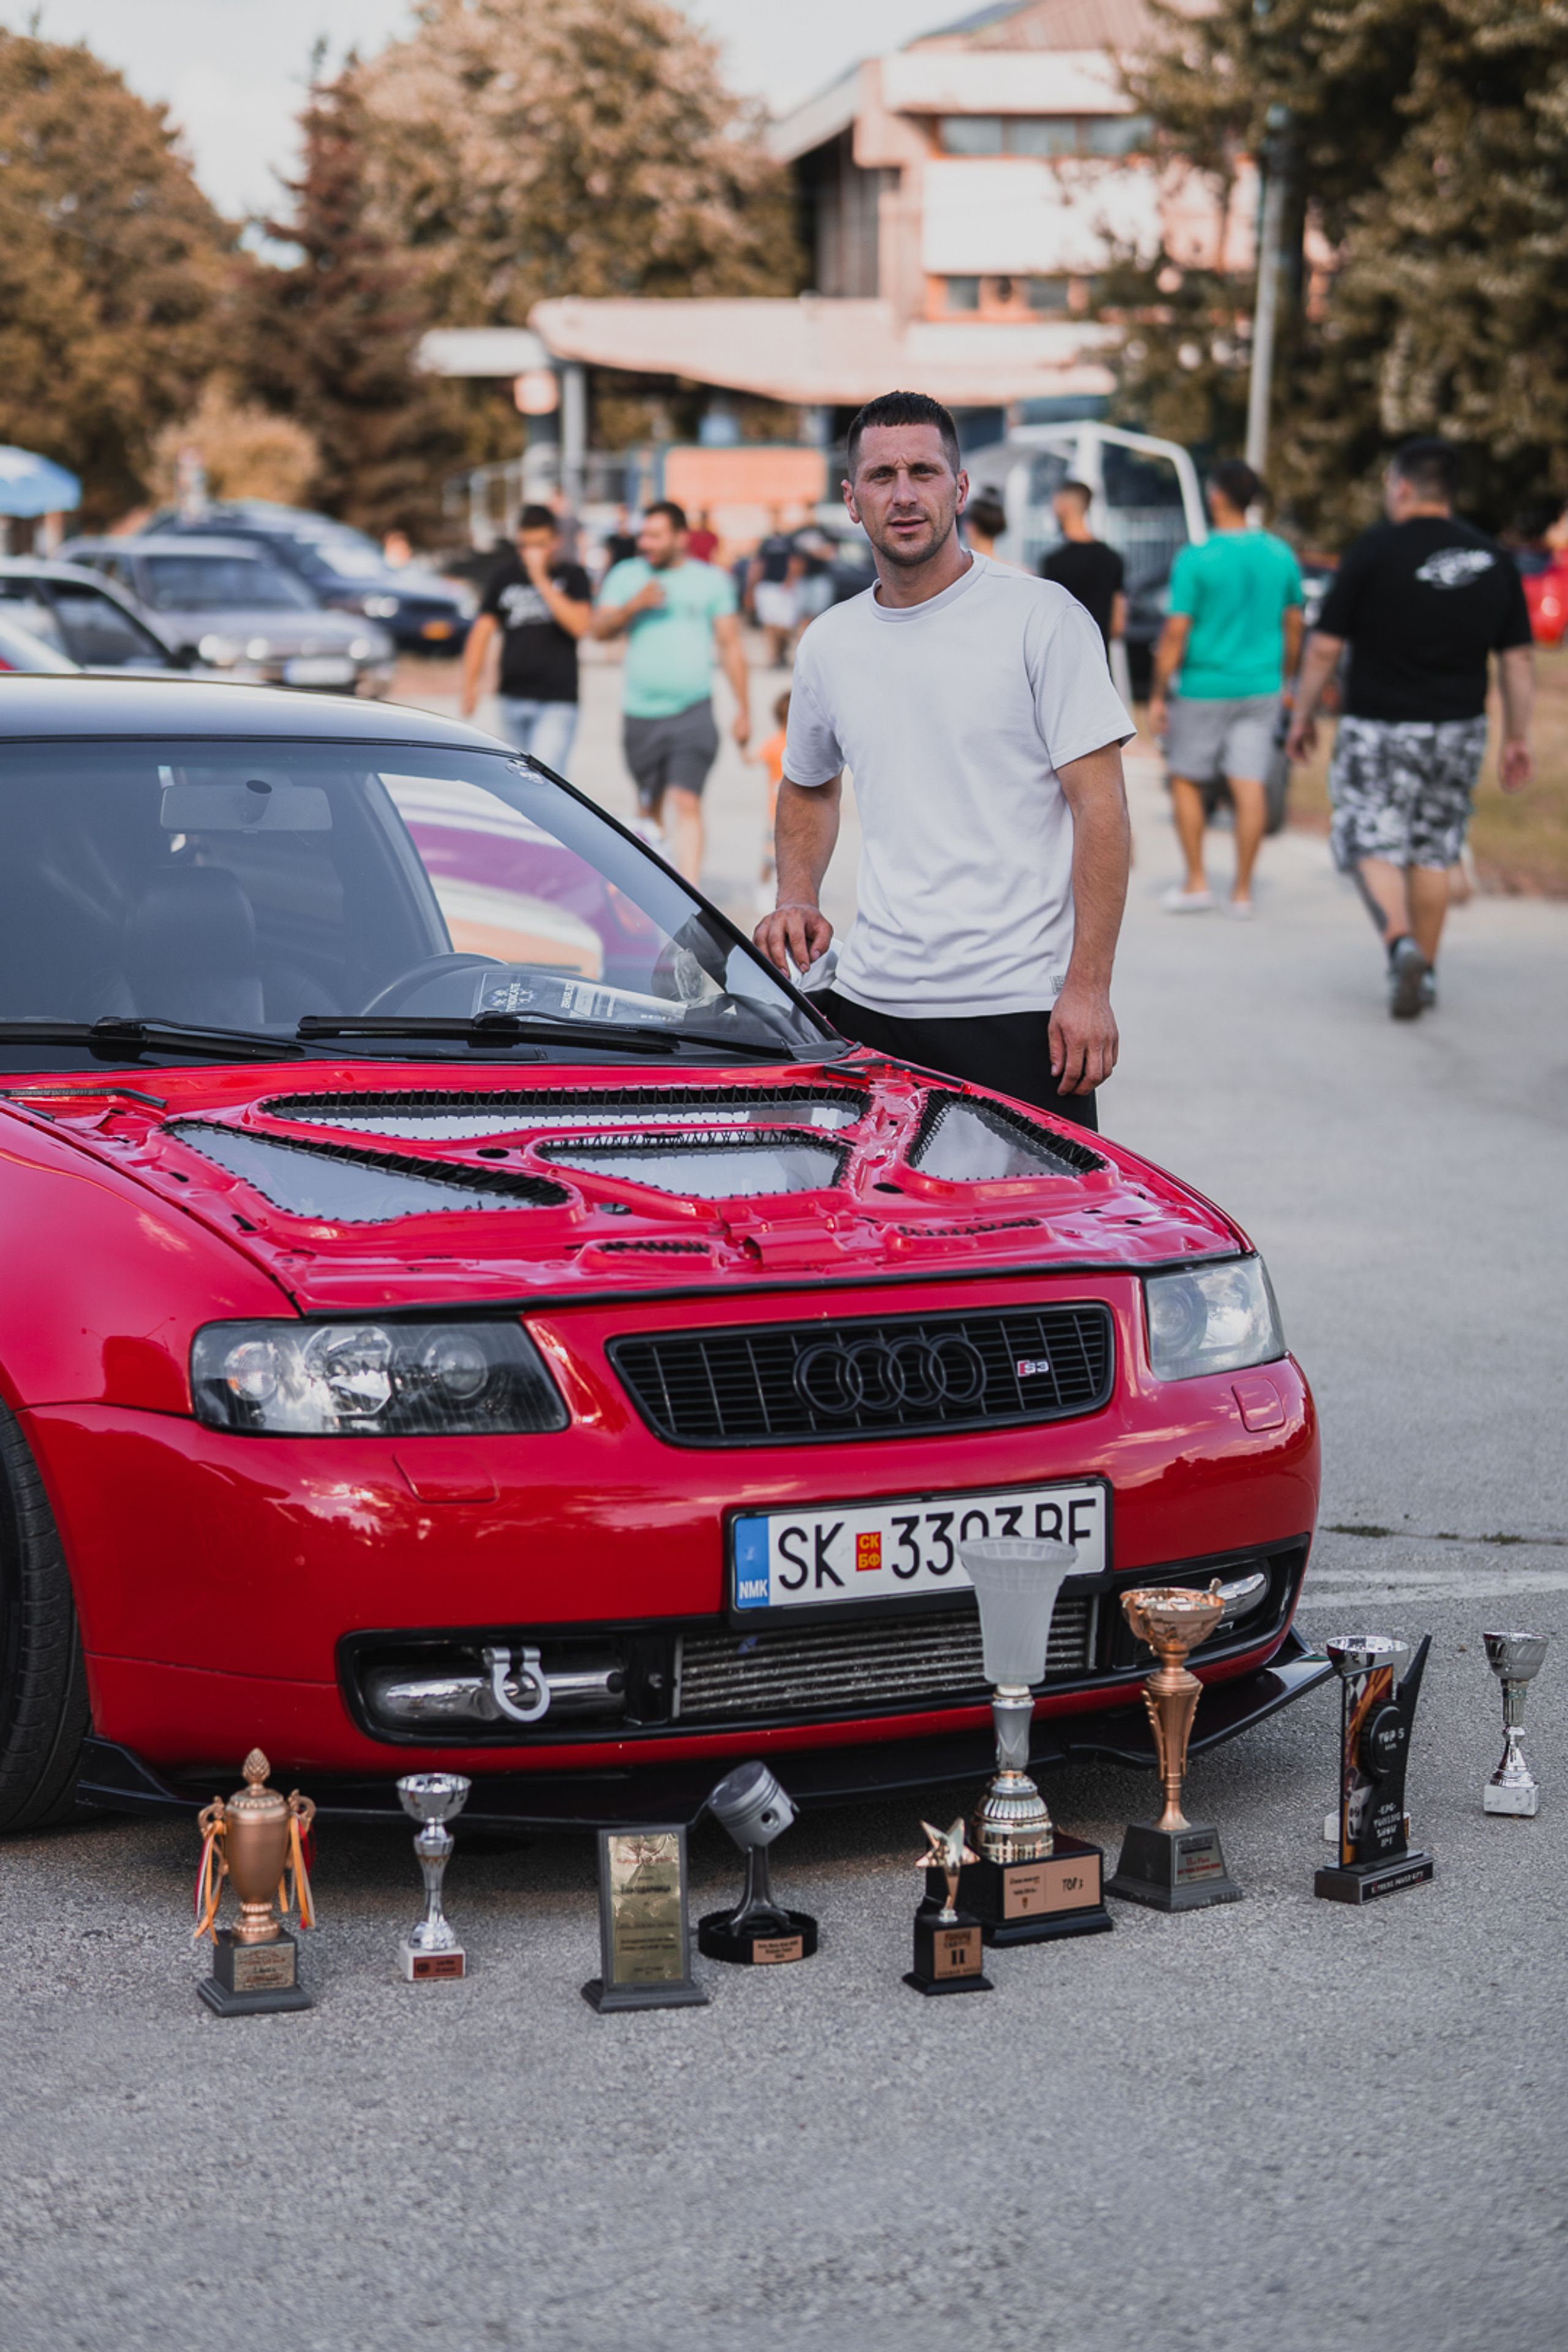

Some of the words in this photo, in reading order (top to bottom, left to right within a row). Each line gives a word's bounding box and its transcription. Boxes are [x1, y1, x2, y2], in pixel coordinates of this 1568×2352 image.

[1024, 1361, 1049, 1374] S3
[859, 1536, 879, 1550] СК
[778, 1522, 845, 1590] SK
[858, 1553, 880, 1569] БФ
[739, 1580, 768, 1600] NMK
[1378, 1730, 1396, 1744] TOP
[1398, 1727, 1405, 1739] 5
